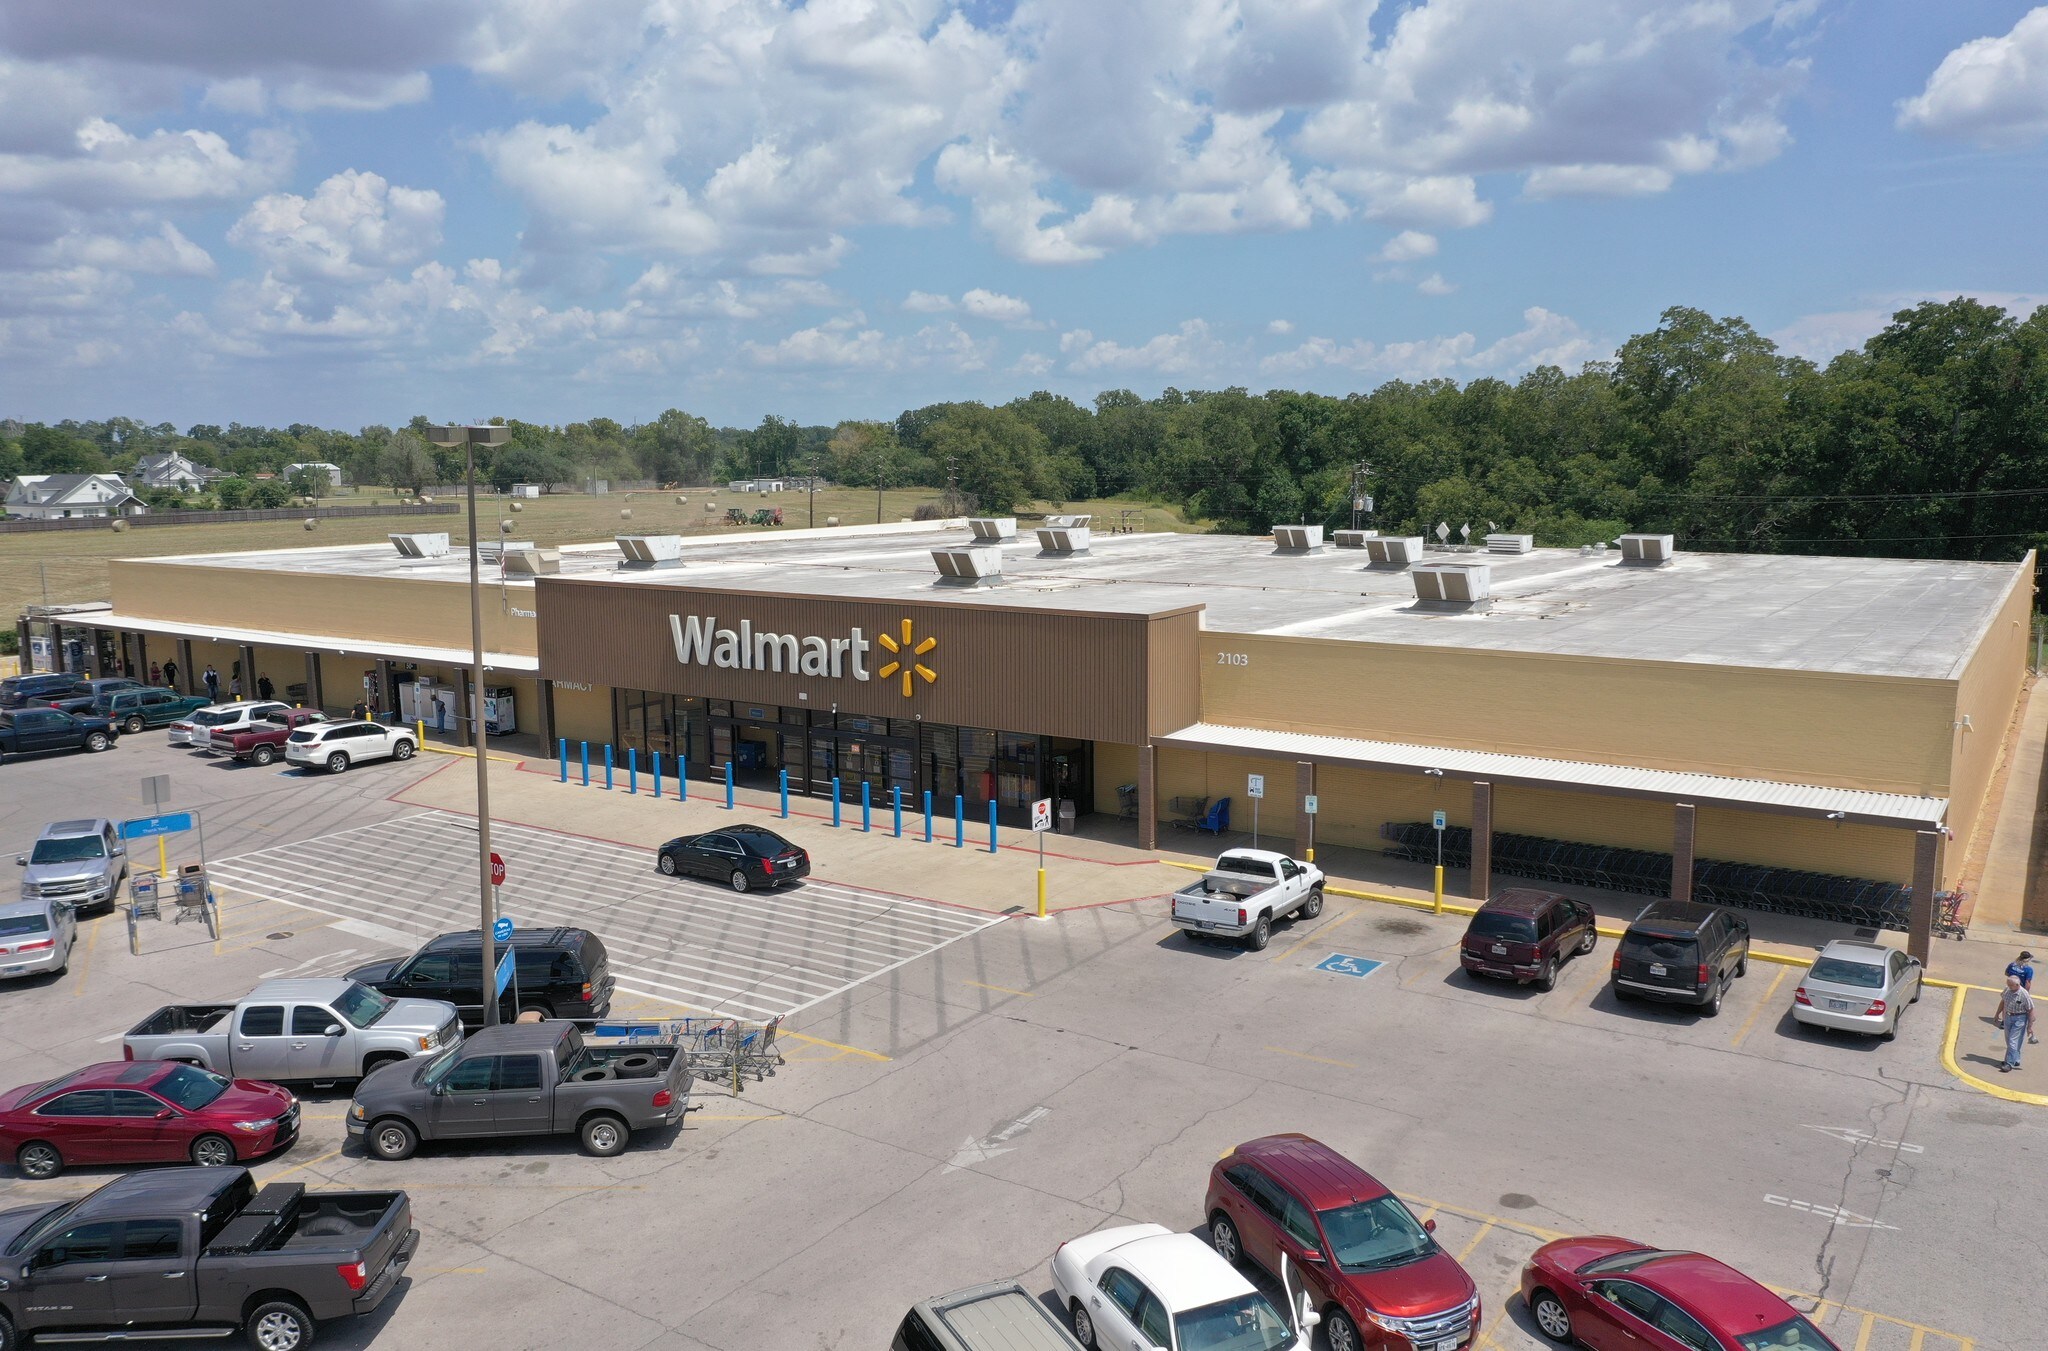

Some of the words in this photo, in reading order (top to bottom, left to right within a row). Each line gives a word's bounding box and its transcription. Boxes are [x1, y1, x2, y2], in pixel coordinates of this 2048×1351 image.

[510, 607, 537, 618] Pharma
[669, 613, 870, 682] Walmart
[1217, 652, 1249, 666] 2103
[551, 679, 593, 692] ARMACY
[490, 862, 504, 877] TOP
